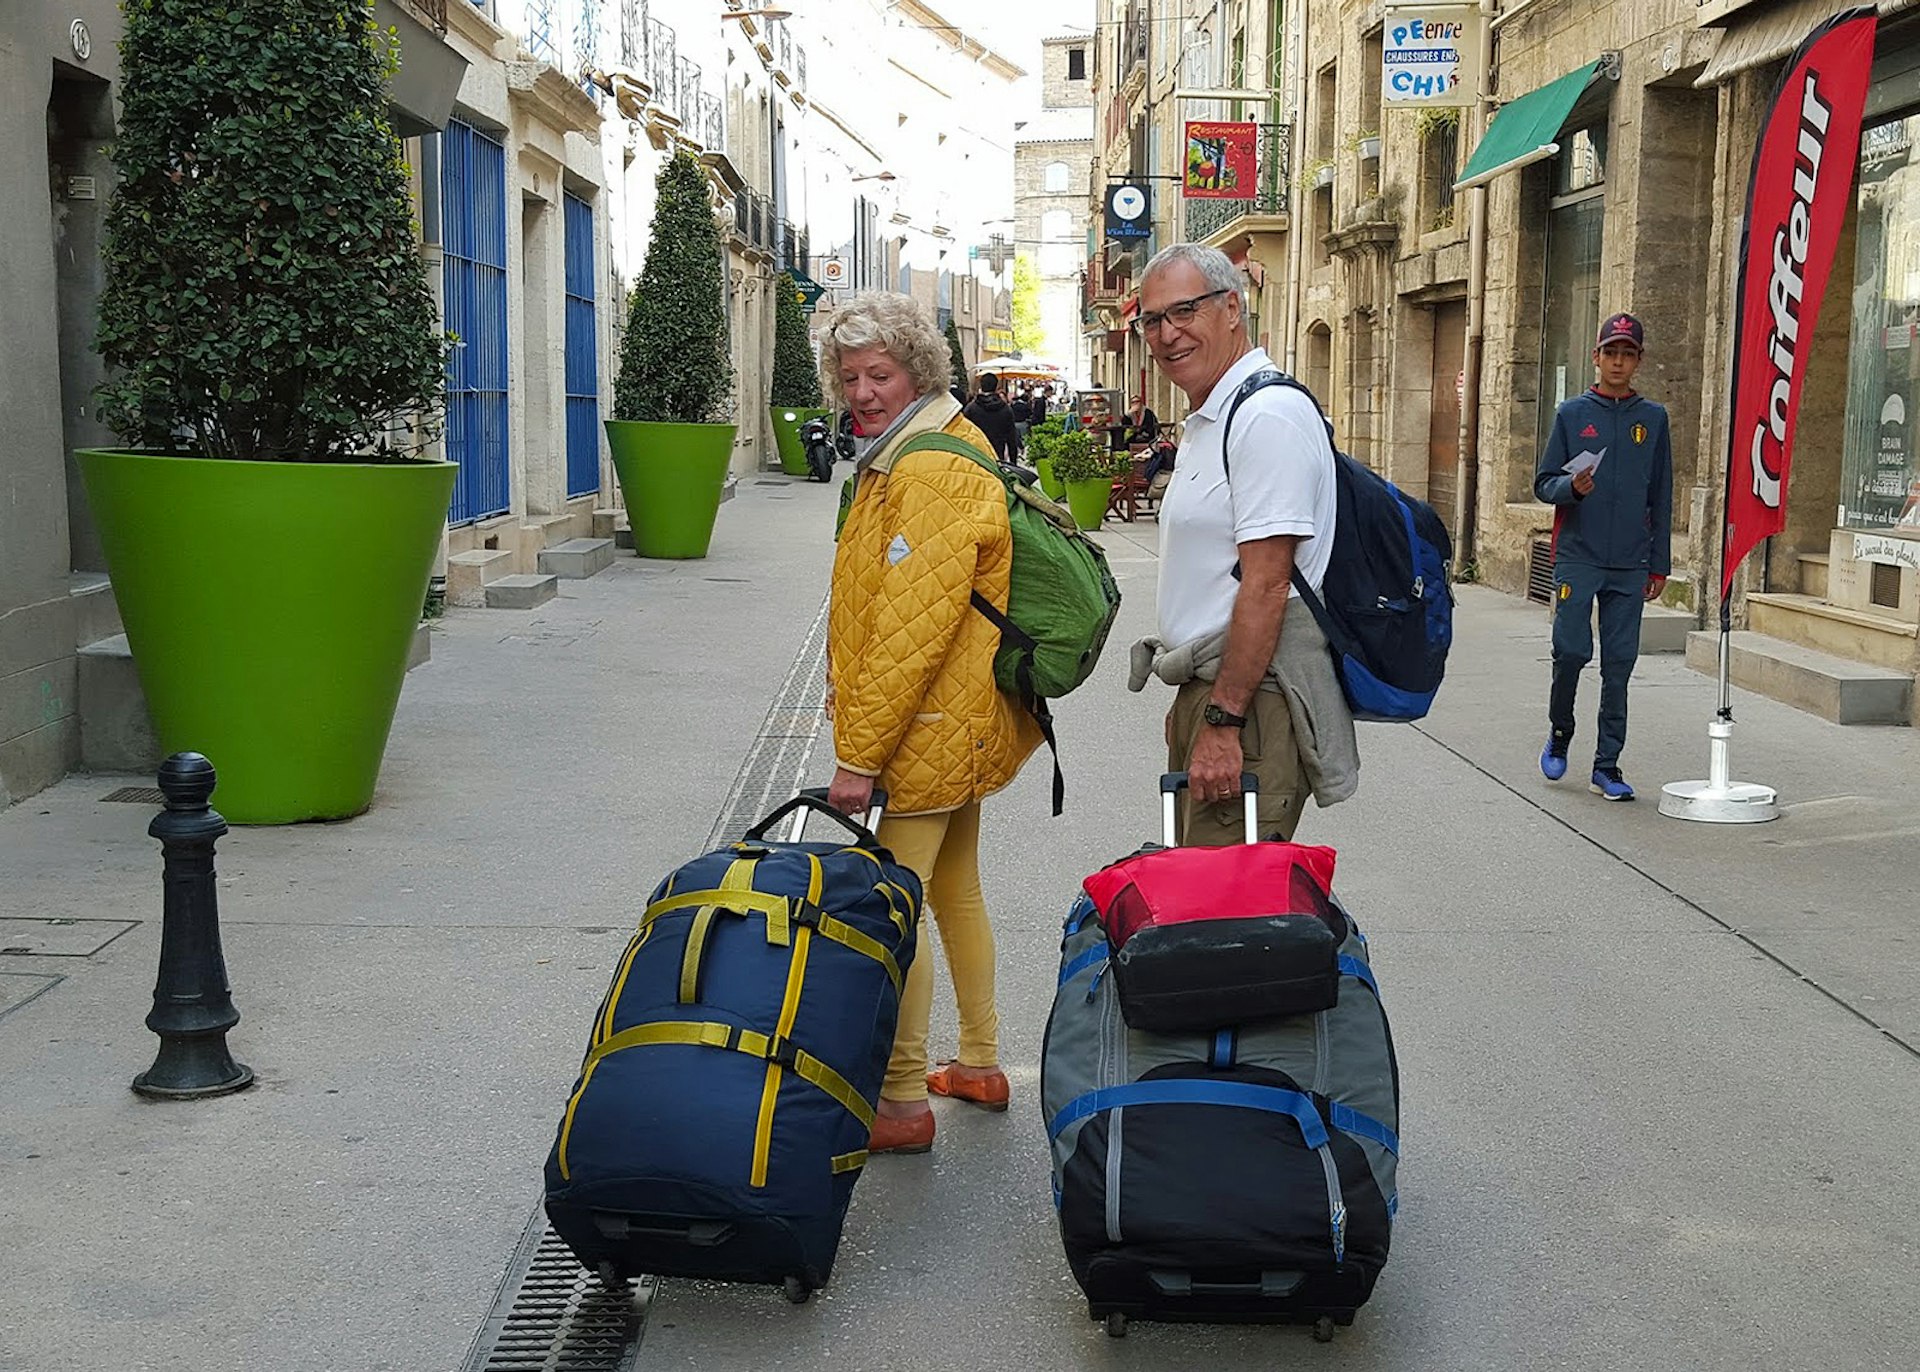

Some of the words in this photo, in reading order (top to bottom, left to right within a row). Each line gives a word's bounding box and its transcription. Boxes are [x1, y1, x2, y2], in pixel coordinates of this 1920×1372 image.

[1385, 48, 1440, 62] CHAUSSURES
[1751, 68, 1831, 508] Coiffeur
[1881, 436, 1902, 450] BRAIN
[1877, 452, 1905, 466] DAMAGE
